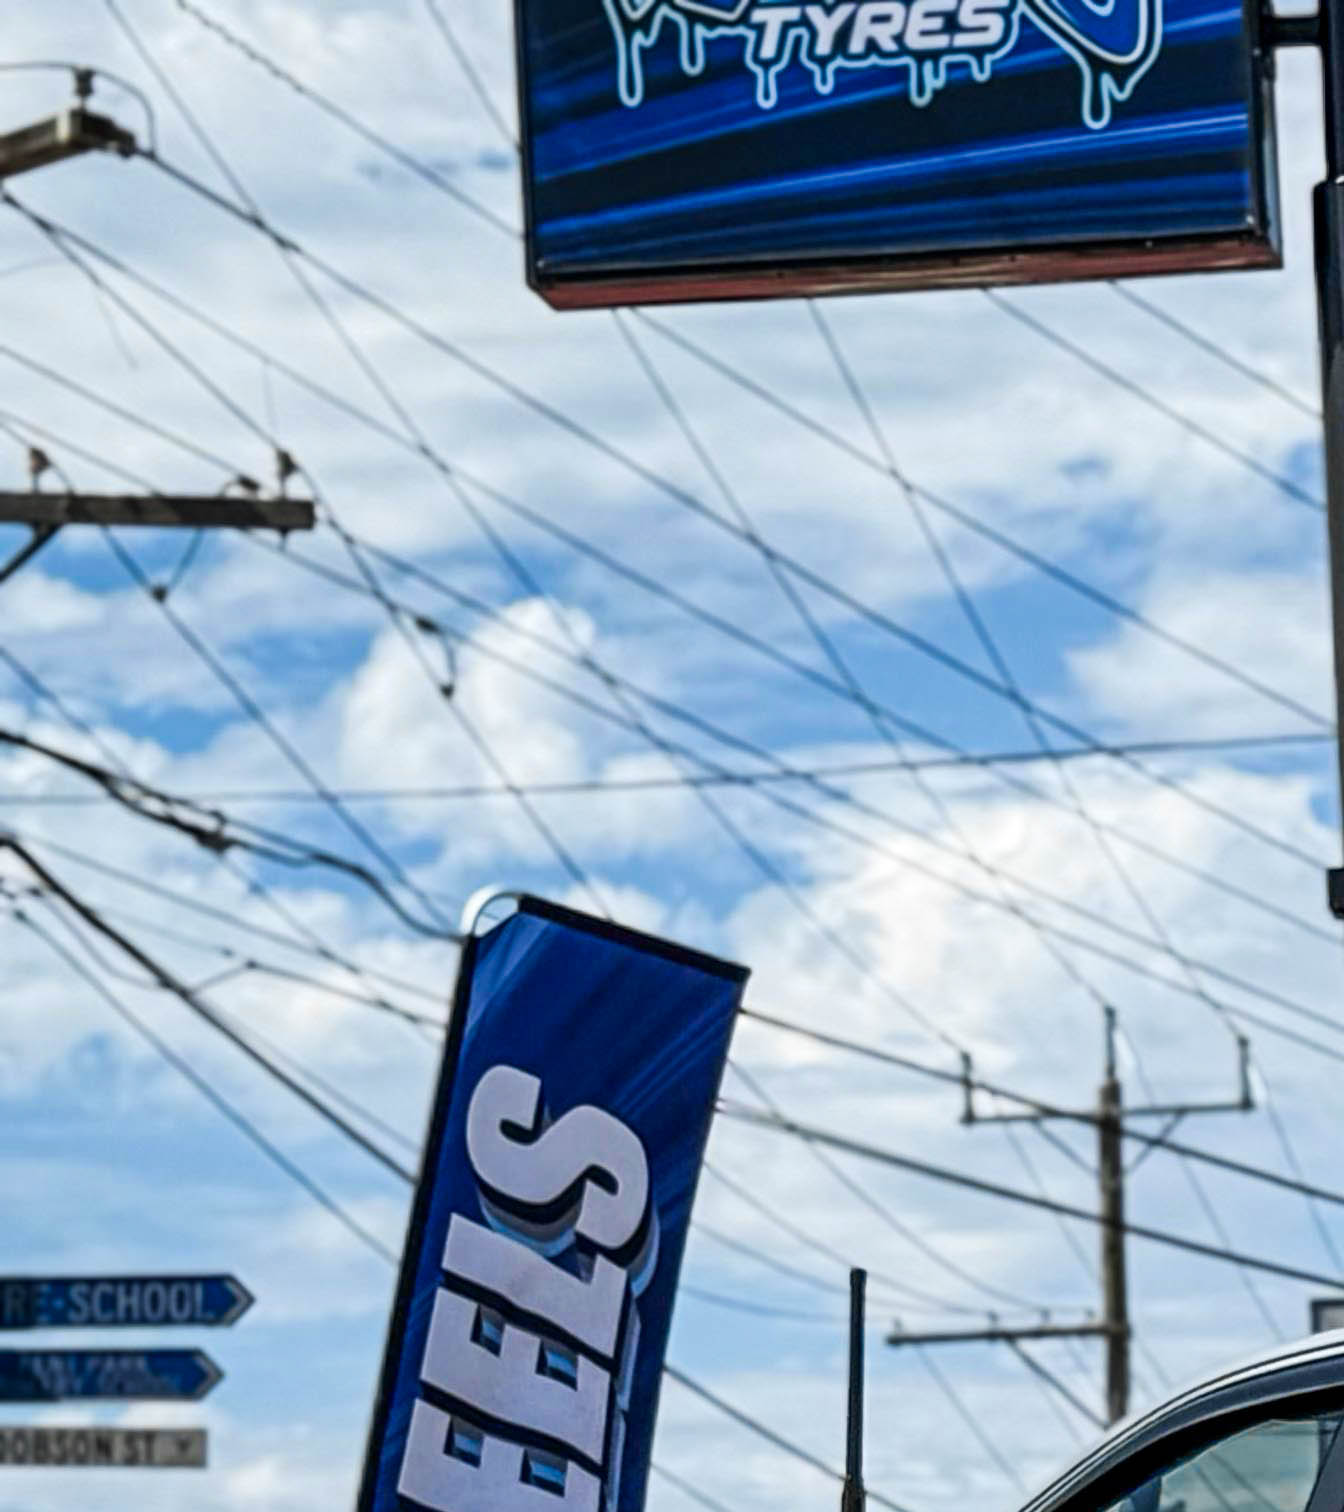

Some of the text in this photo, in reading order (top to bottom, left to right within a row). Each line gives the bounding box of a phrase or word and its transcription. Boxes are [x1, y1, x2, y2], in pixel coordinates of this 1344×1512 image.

[751, 0, 1010, 59] TYRES
[0, 1429, 157, 1464] OBSON ST
